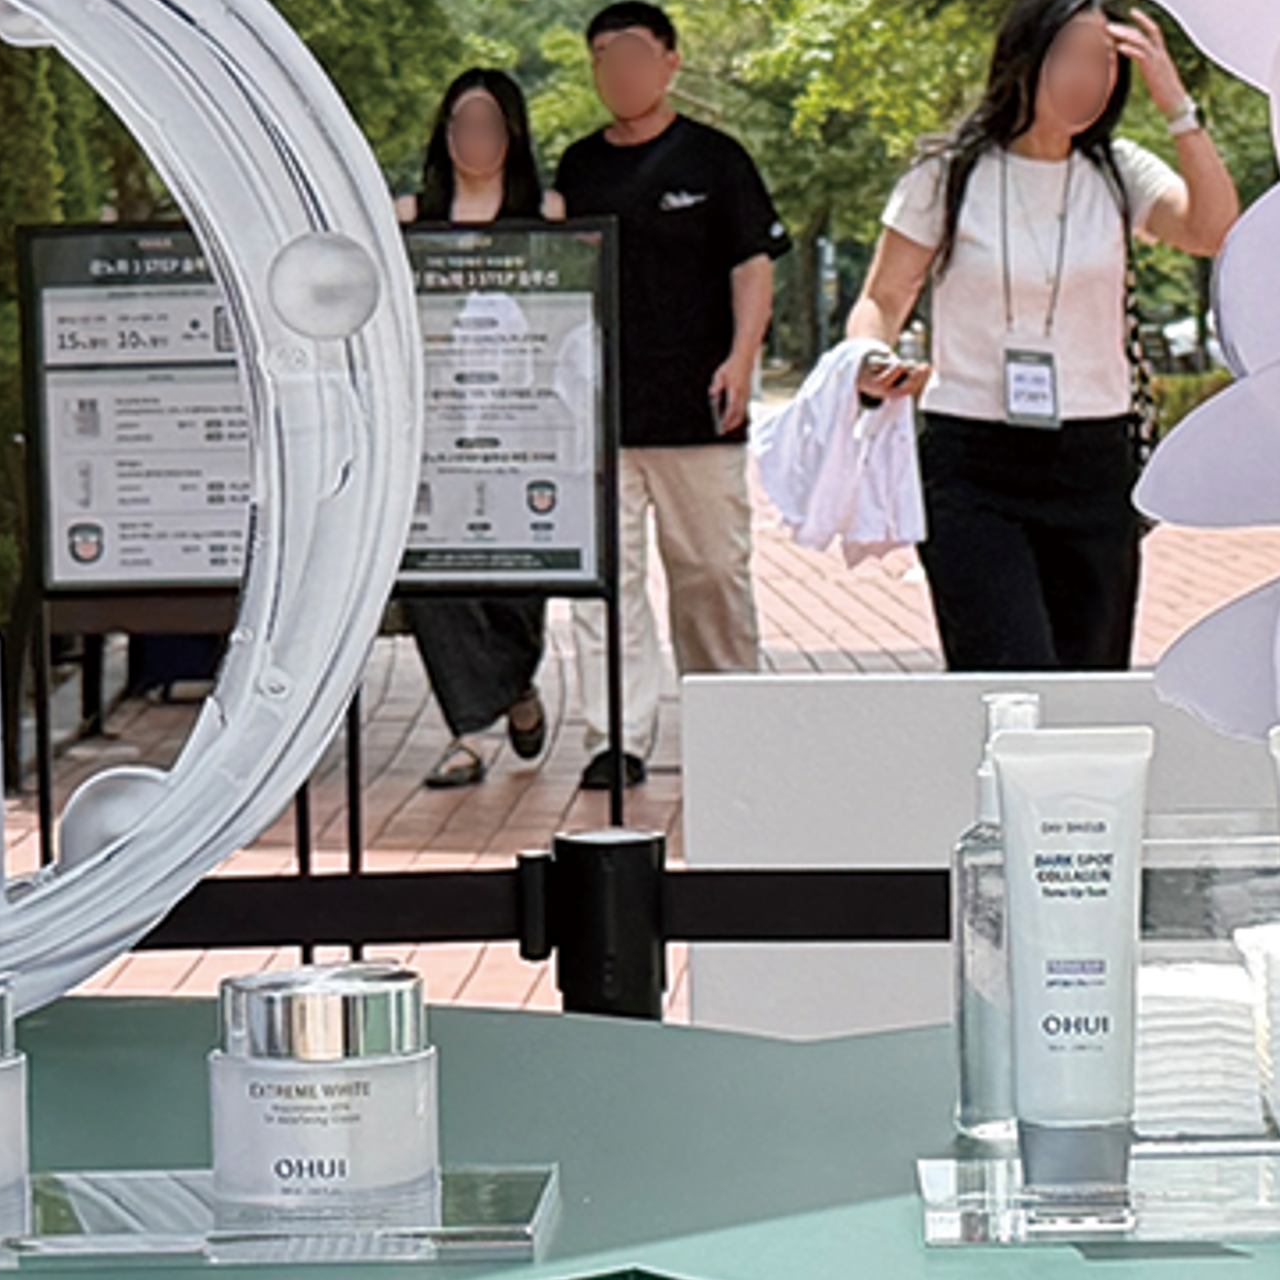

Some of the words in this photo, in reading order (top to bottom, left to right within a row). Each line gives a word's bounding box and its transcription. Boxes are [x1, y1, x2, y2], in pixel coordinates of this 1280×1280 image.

[1034, 853, 1073, 869] DARK
[1077, 853, 1114, 868] SPOT
[1036, 869, 1111, 883] COLLAGEN
[1041, 1013, 1109, 1036] OHUI
[274, 1159, 347, 1180] OHUI
